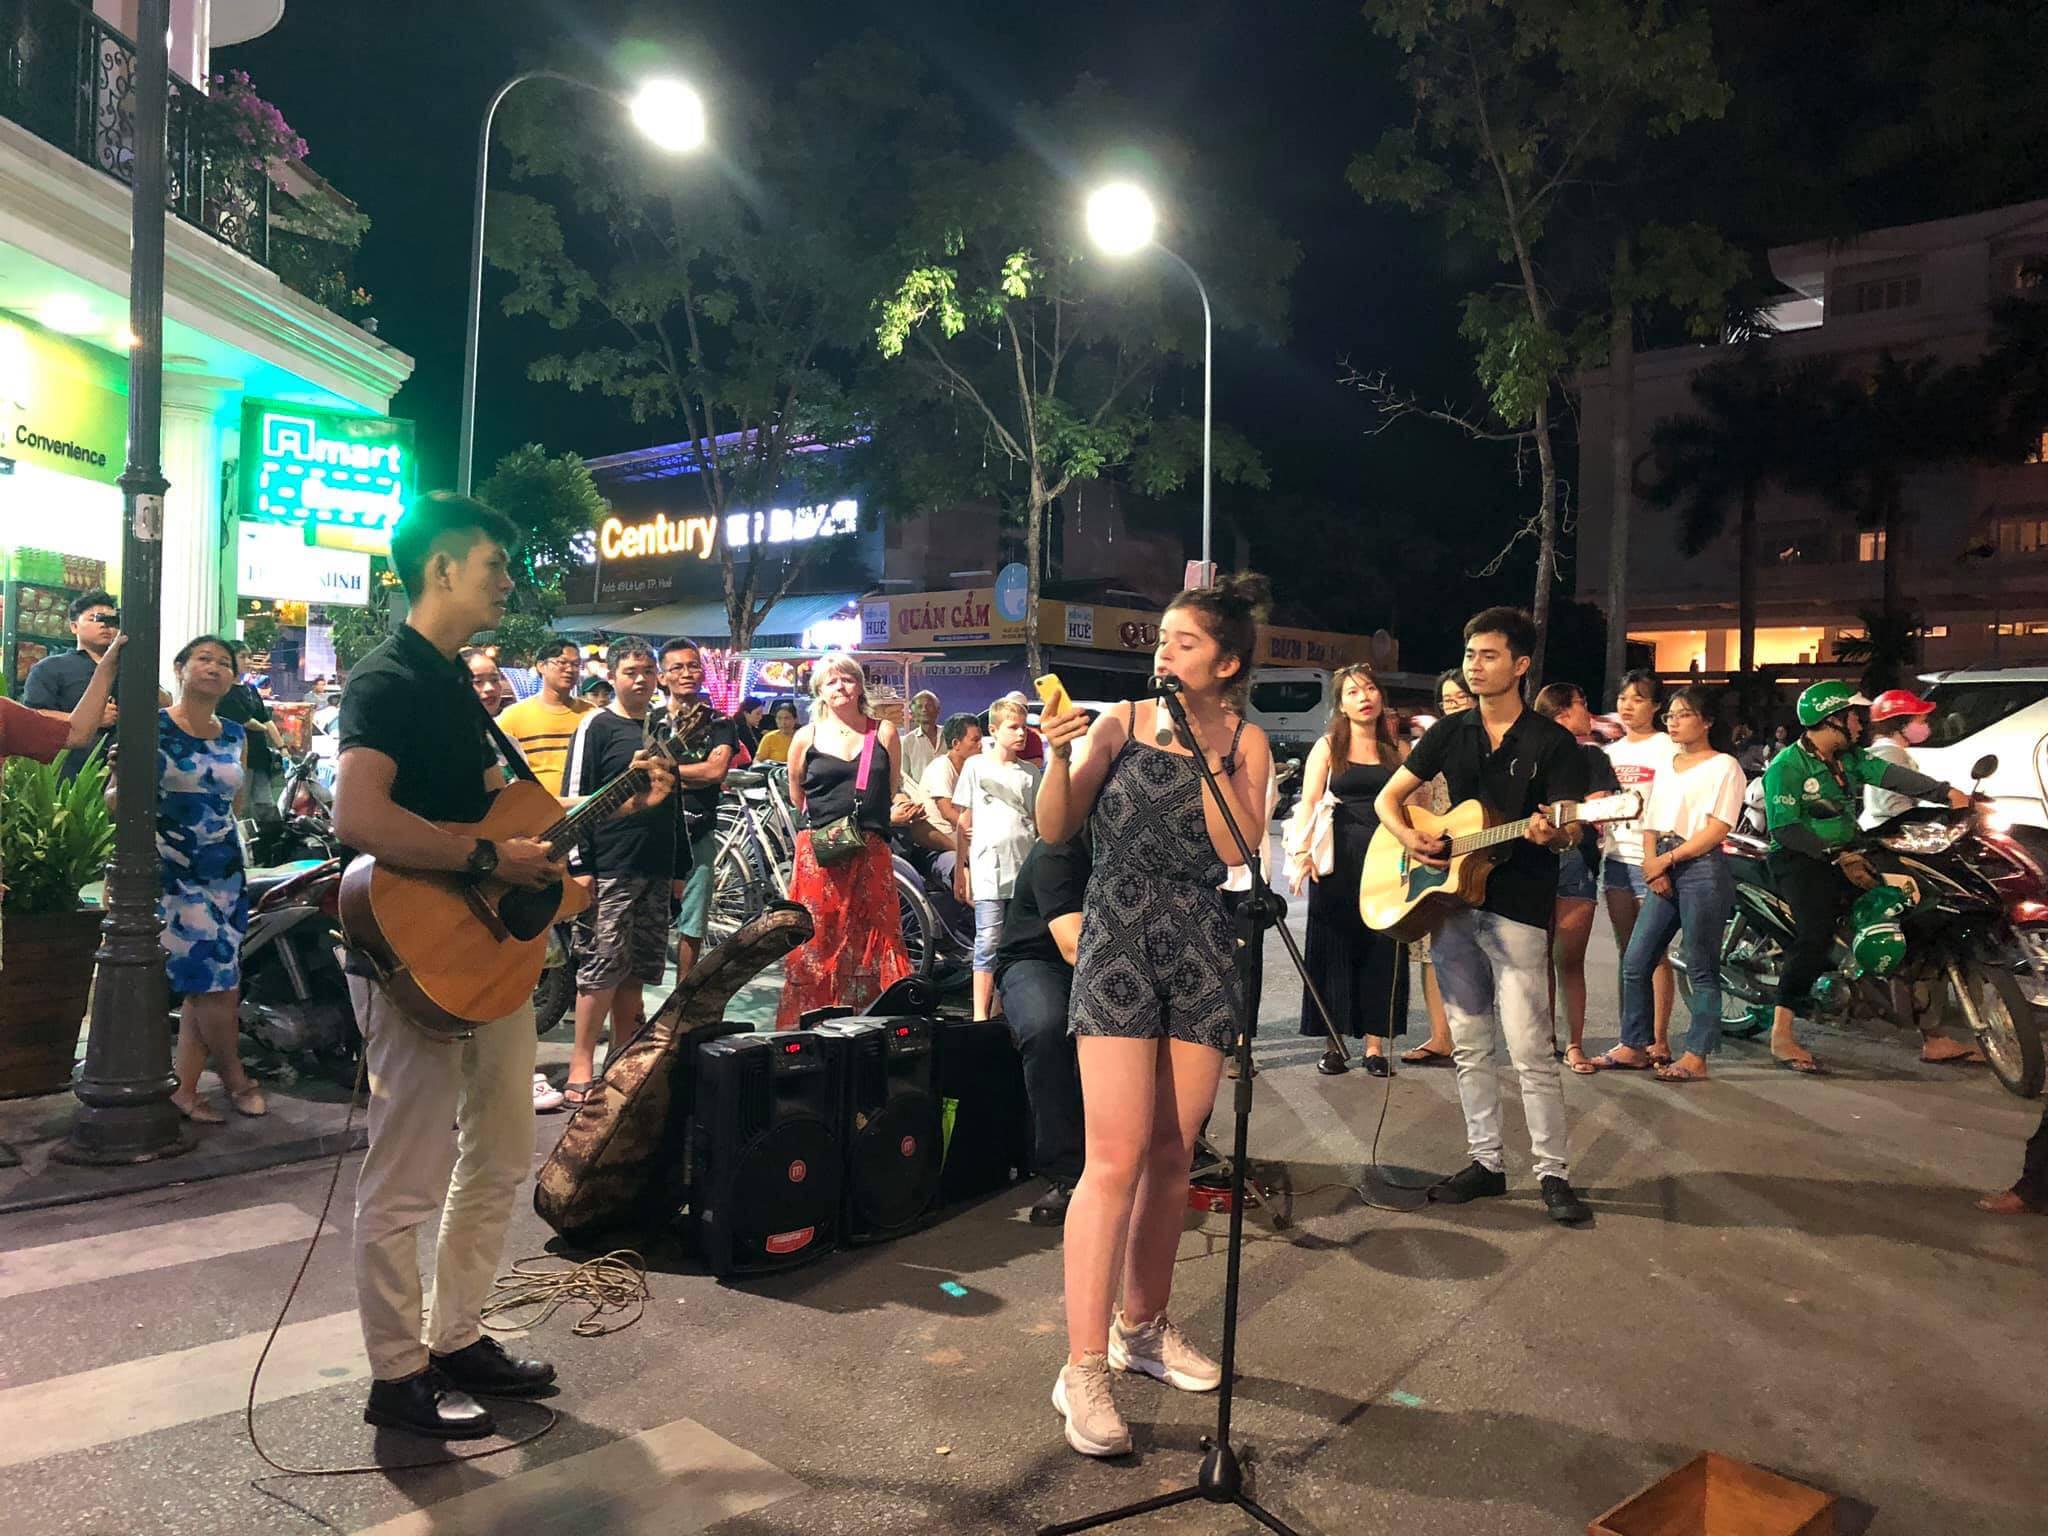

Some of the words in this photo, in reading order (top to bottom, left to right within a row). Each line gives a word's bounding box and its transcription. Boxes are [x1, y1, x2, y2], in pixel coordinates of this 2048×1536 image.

[16, 424, 106, 467] Convenience
[600, 513, 718, 559] Century
[899, 601, 945, 634] QUÁN
[951, 591, 990, 628] CẨM
